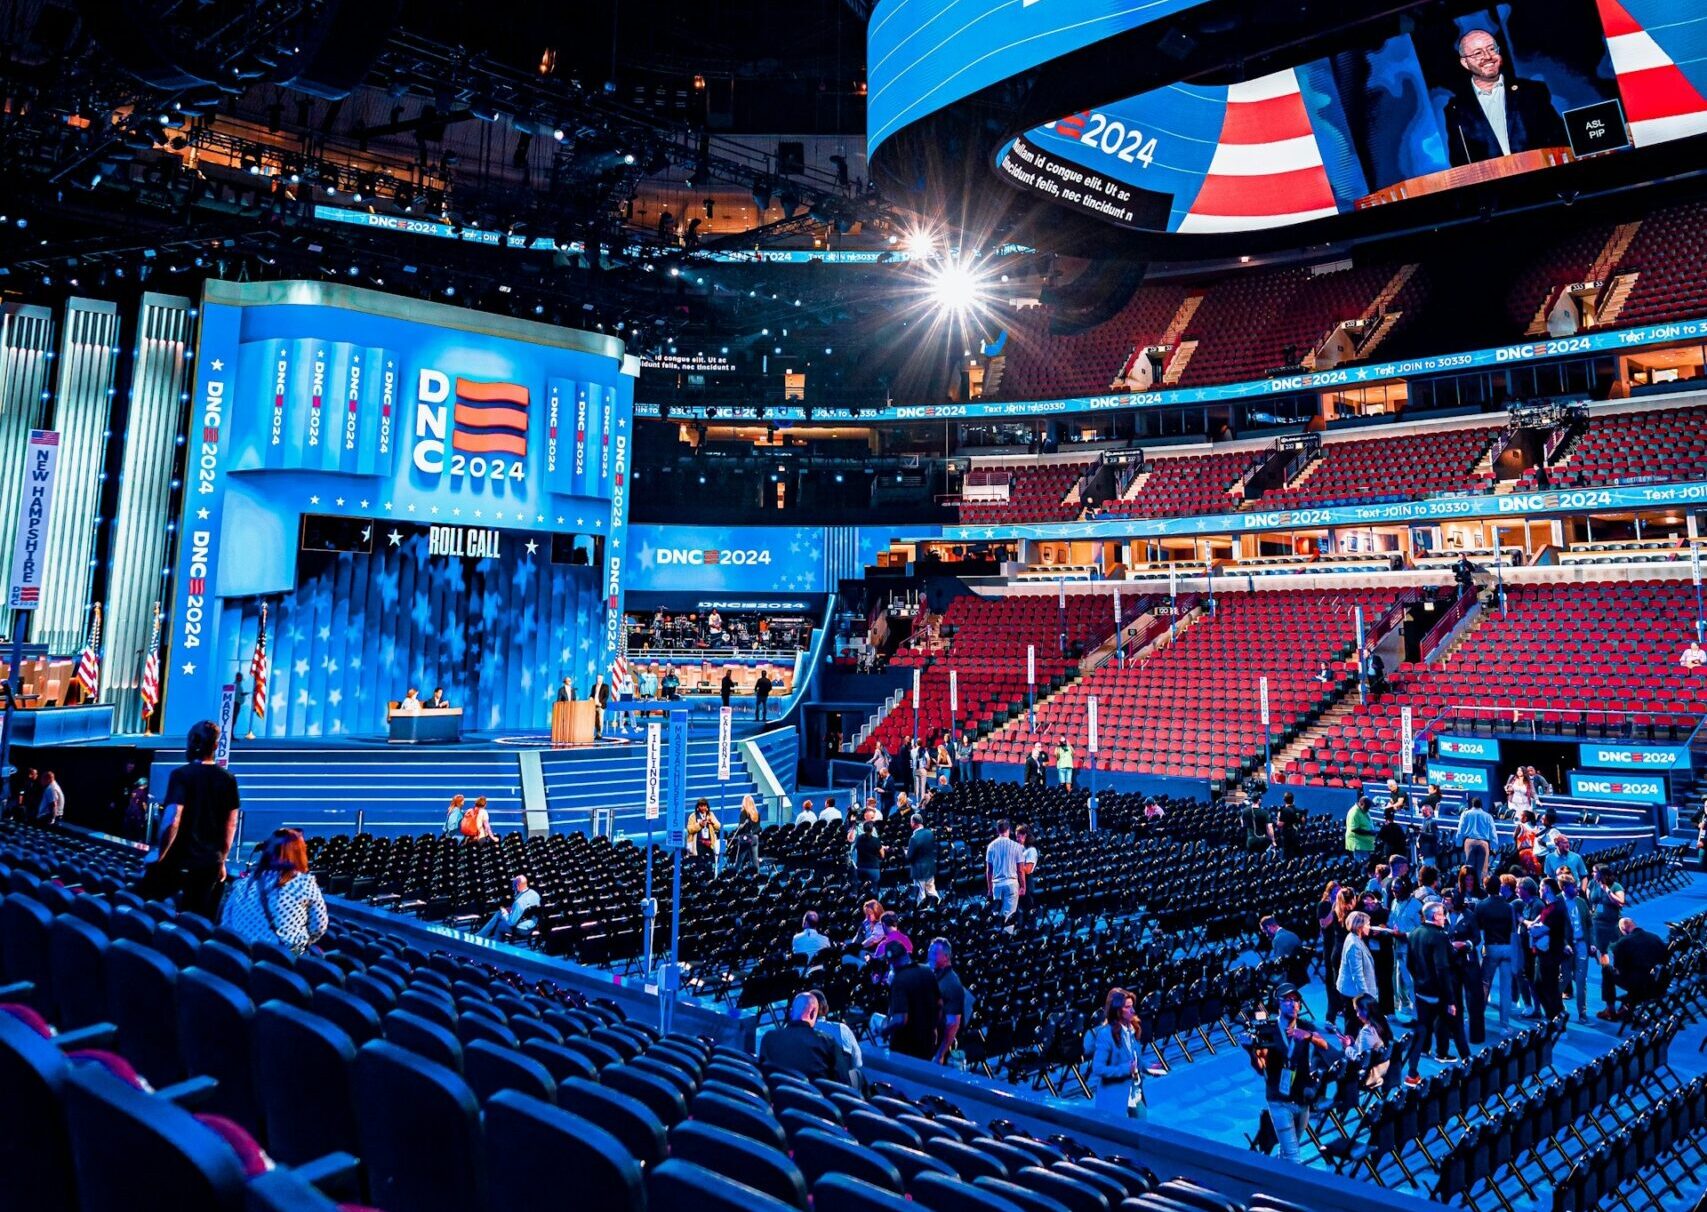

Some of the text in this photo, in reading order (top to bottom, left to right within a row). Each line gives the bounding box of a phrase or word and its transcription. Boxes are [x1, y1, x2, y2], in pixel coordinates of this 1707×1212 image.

[1080, 113, 1158, 168] 2024
[1586, 120, 1605, 130] ASL
[1588, 128, 1606, 139] PIP
[1034, 153, 1045, 168] id
[1046, 160, 1082, 184] congue
[1084, 175, 1102, 192] elit.
[1105, 183, 1118, 198] Ut
[1118, 189, 1131, 202] ac
[1036, 175, 1060, 197] felis,
[1062, 188, 1082, 202] nec
[1082, 194, 1126, 220] tincidunt
[1126, 211, 1134, 222] n
[1618, 330, 1645, 344] Text
[1648, 326, 1680, 340] JOIN
[1684, 324, 1696, 335] to
[664, 356, 690, 364] congue
[1374, 366, 1395, 376] Text
[1398, 362, 1424, 374] JOIN
[1425, 360, 1436, 369] to
[1437, 355, 1472, 368] 30330
[32, 450, 49, 482] NEW
[450, 454, 526, 482] 2024
[1642, 487, 1676, 500] Text
[1354, 508, 1380, 519] Text
[1382, 506, 1412, 518] JOIN
[1414, 506, 1427, 516] to
[1429, 502, 1470, 514] 30330
[22, 486, 45, 583] HAMPSHIRE
[429, 526, 501, 558] ROLL CALL
[218, 693, 232, 758] MARYLAND
[650, 734, 658, 804] ILLINOIS
[672, 725, 682, 828] MASSACHUSETTS
